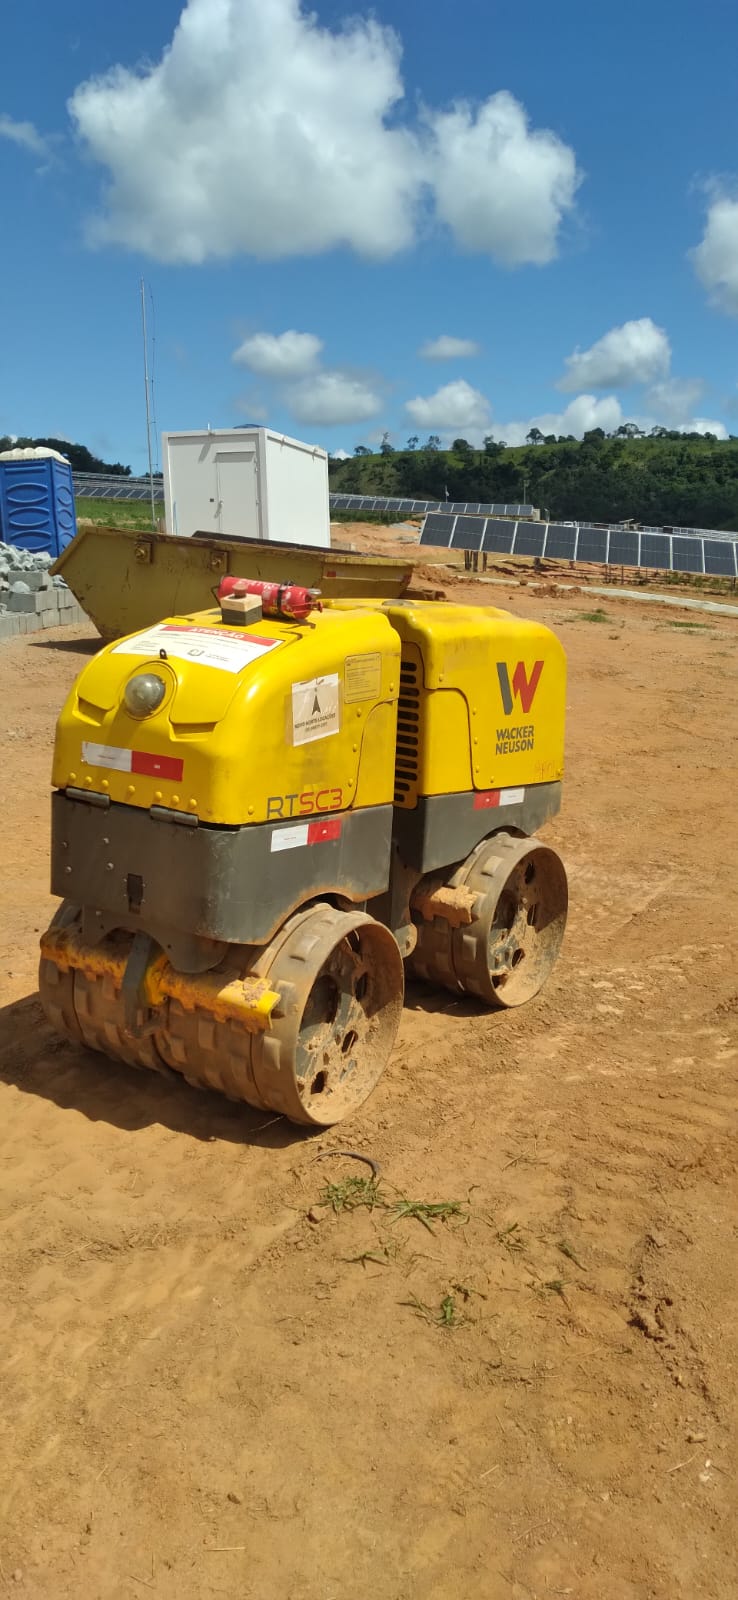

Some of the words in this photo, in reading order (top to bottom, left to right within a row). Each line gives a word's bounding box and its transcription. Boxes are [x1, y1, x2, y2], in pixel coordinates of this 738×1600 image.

[189, 626, 245, 639] ATENÇÃO
[496, 725, 535, 741] WACKER
[495, 738, 535, 756] NEUSON
[266, 787, 343, 819] RTSC3
